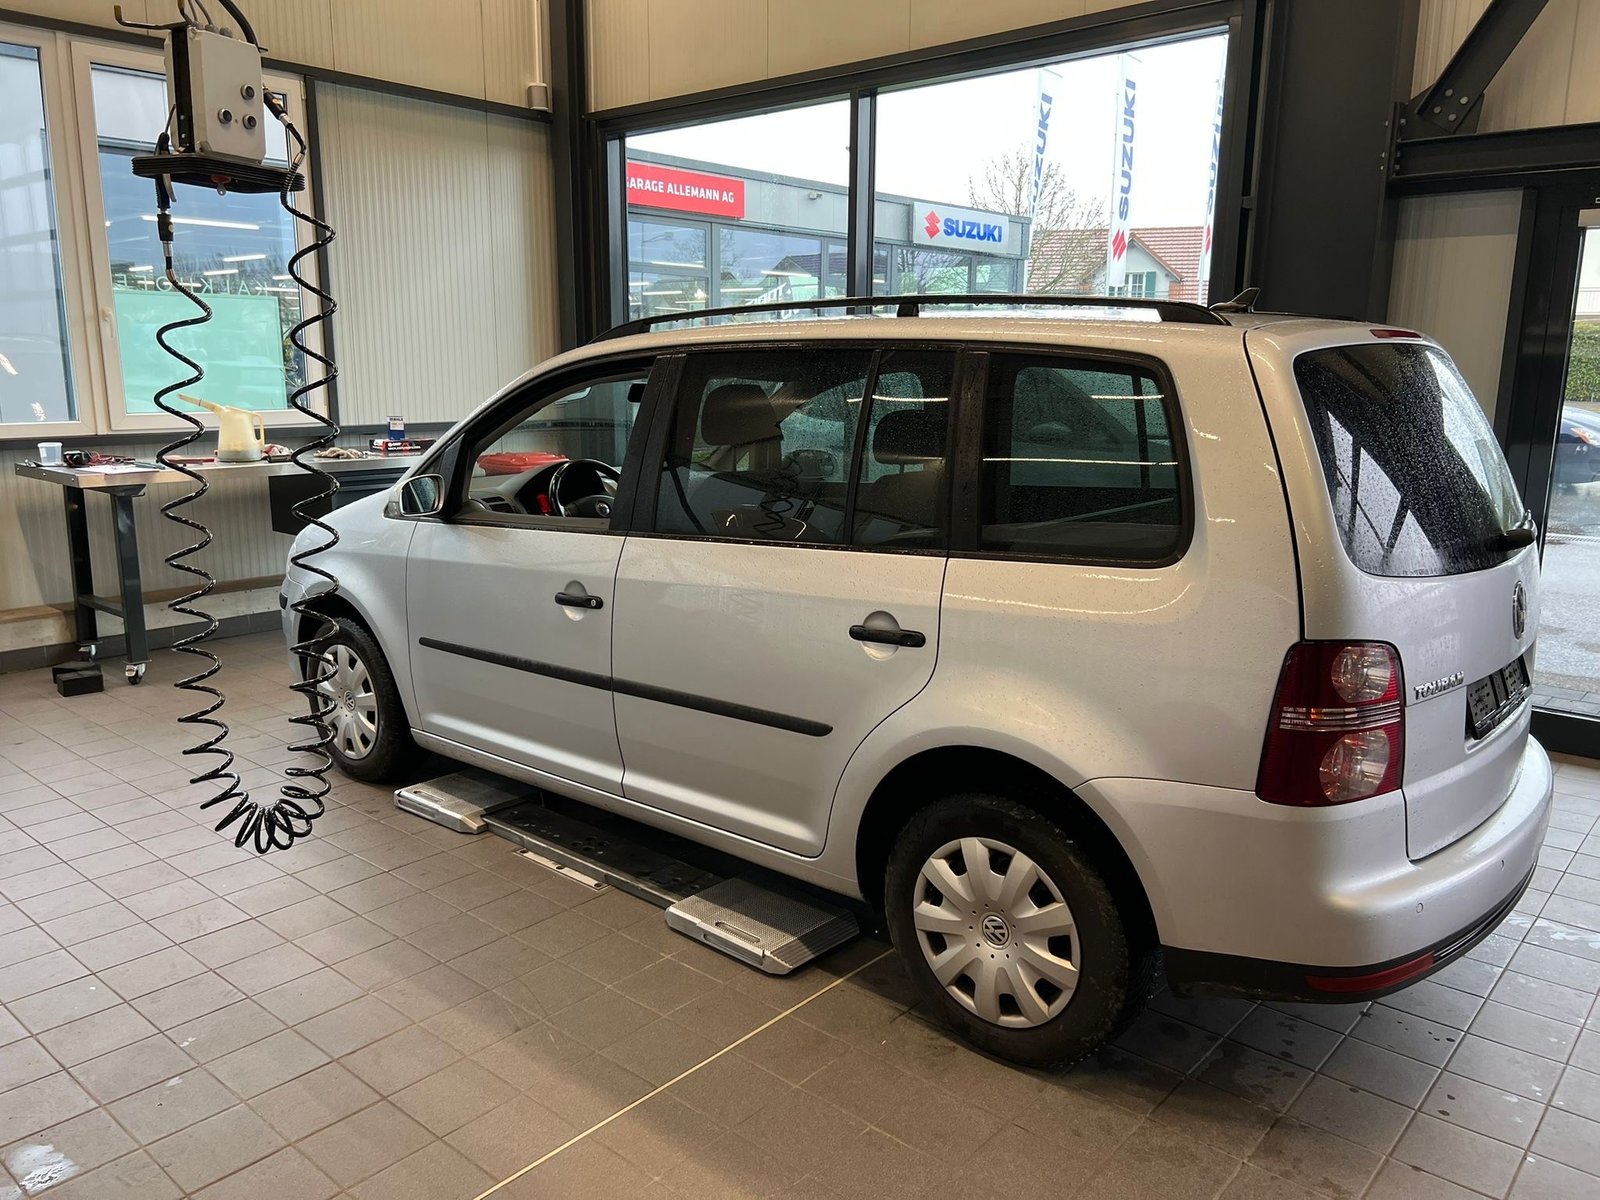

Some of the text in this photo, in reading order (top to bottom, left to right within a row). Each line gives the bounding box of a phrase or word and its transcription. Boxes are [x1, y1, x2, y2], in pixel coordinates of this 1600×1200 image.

[1032, 92, 1053, 214] UZUKI
[1119, 79, 1136, 221] SUZUKI
[667, 183, 719, 201] ALLEMANN
[722, 191, 734, 203] AG
[943, 217, 1002, 243] SUZUKI
